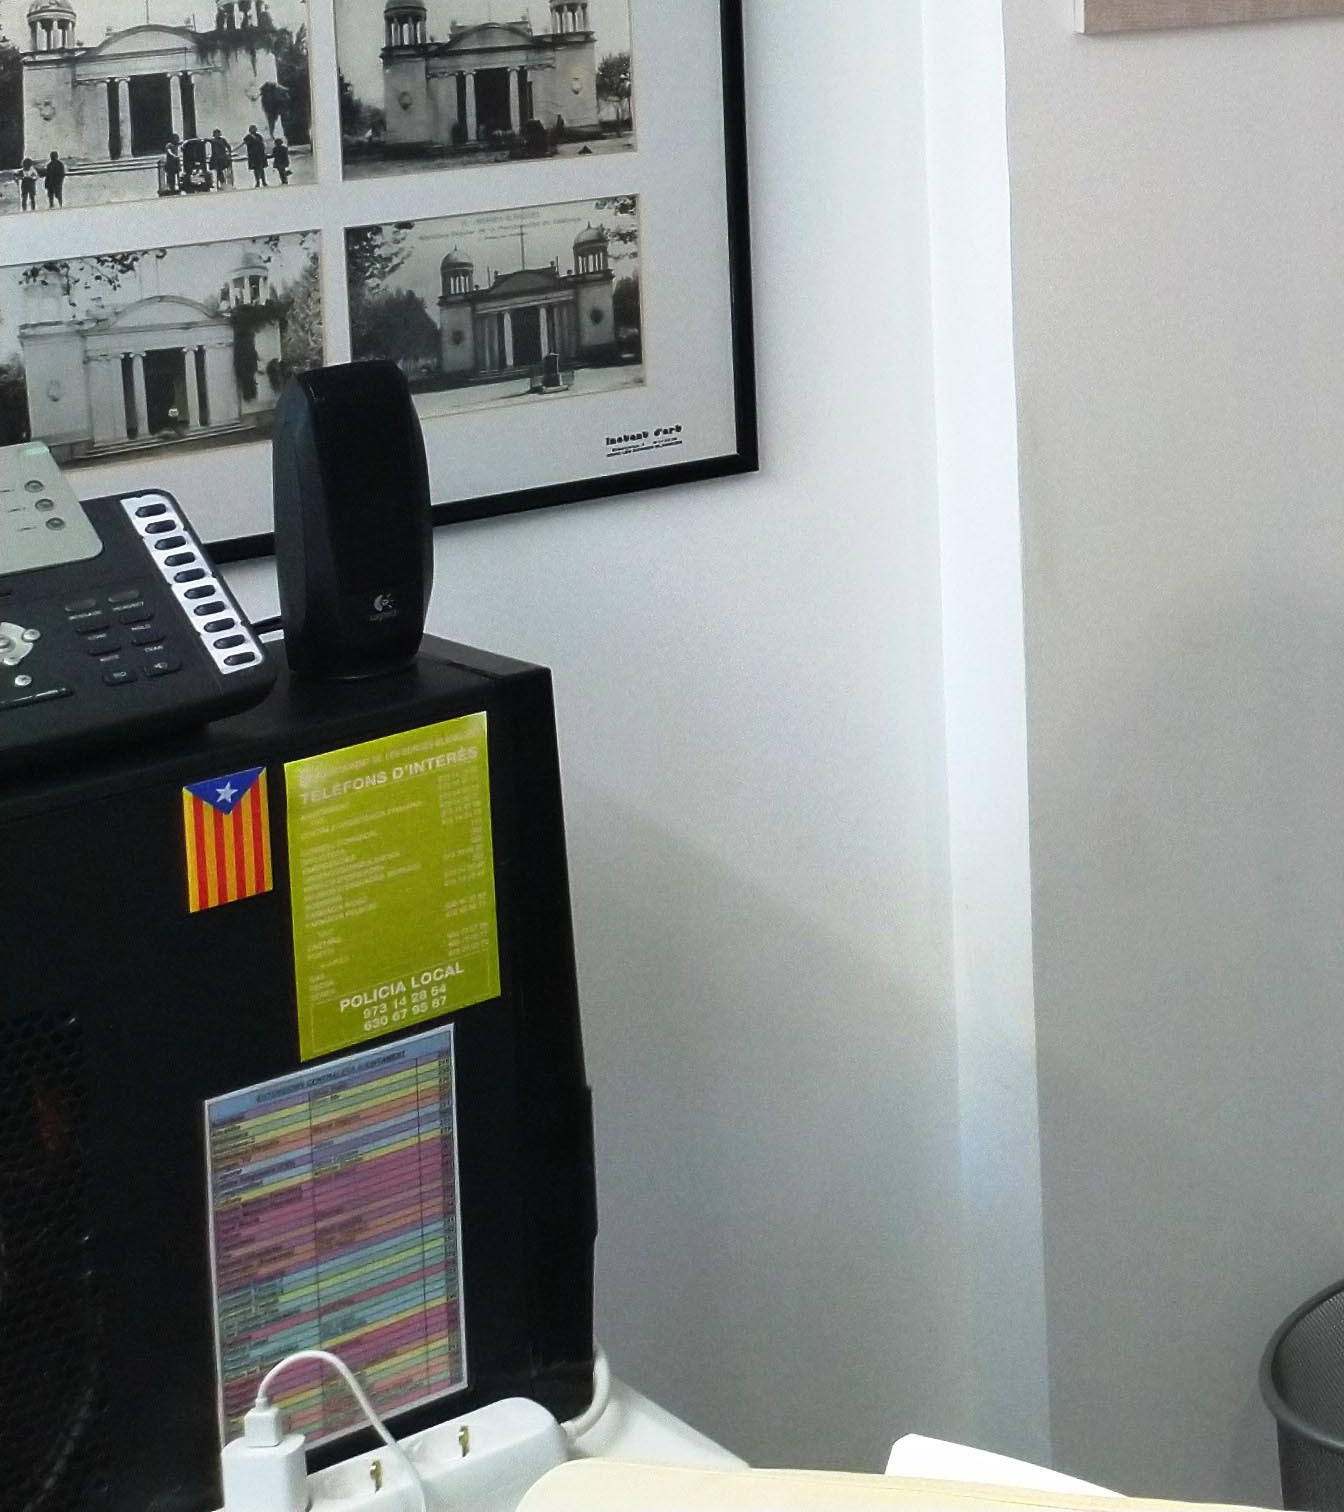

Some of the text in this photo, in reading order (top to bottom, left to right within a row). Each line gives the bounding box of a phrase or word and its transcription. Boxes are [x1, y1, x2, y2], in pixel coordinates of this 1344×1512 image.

[340, 961, 464, 1013] POLICIA LOCAL
[363, 990, 428, 1019] 973 14 28
[363, 1013, 388, 1033] 630
